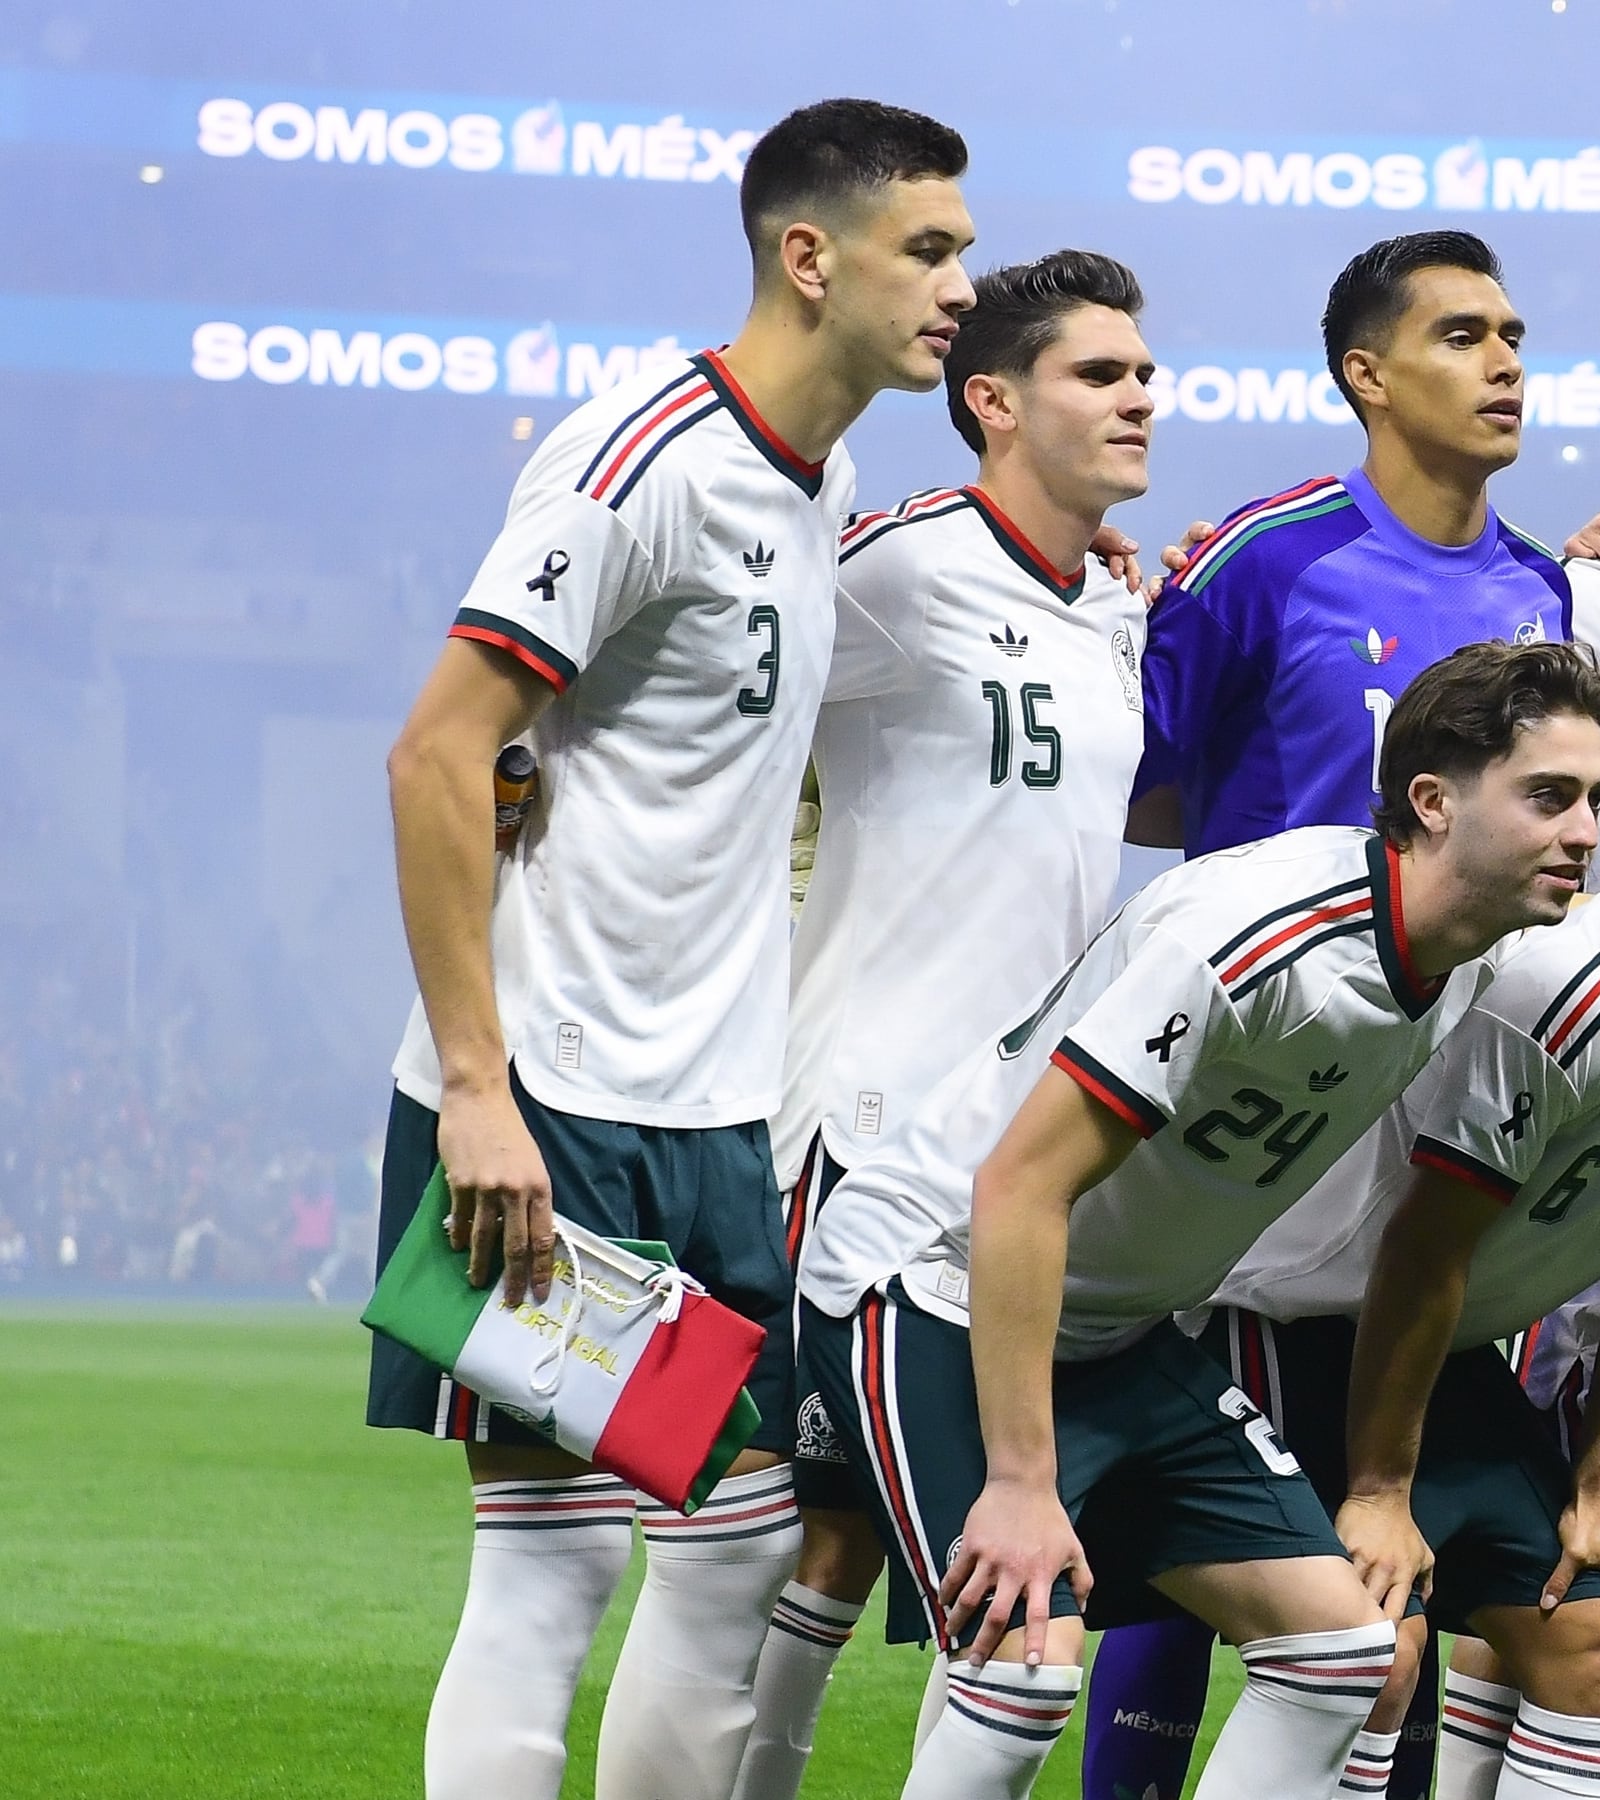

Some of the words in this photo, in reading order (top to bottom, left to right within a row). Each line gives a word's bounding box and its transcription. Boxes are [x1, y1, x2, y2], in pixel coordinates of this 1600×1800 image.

[198, 97, 503, 172] SOMOS
[571, 115, 757, 183] MÉX
[1128, 146, 1428, 210] SOMOS
[190, 322, 498, 394] SOMOS
[1145, 364, 1358, 426] SOMO
[737, 605, 780, 717] 3
[981, 680, 1064, 791] 15
[1183, 1087, 1330, 1188] 24
[1113, 1707, 1196, 1738] MÉXICO
